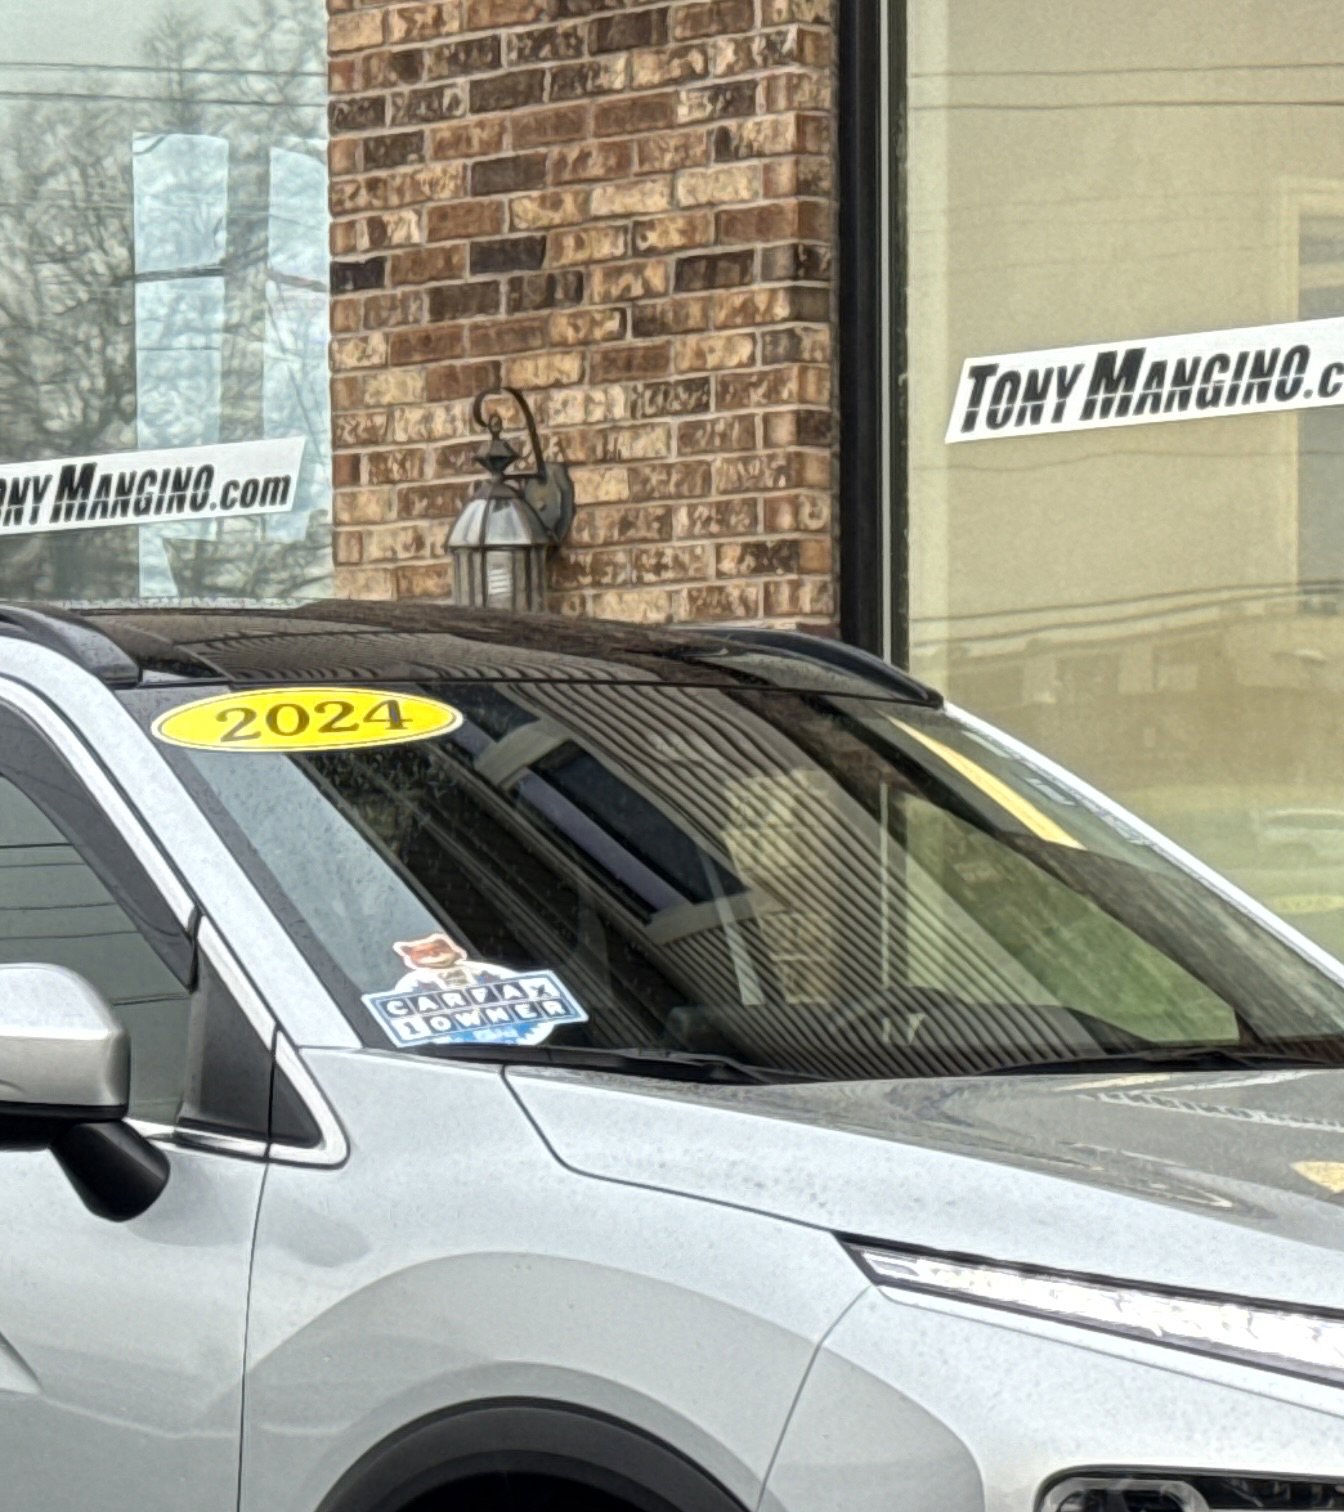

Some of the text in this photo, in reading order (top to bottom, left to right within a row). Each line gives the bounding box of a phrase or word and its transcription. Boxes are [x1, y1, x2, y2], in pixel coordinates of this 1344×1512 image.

[216, 700, 413, 742] 2024
[386, 983, 556, 1015] CARFAX
[429, 1001, 567, 1031] OWNER
